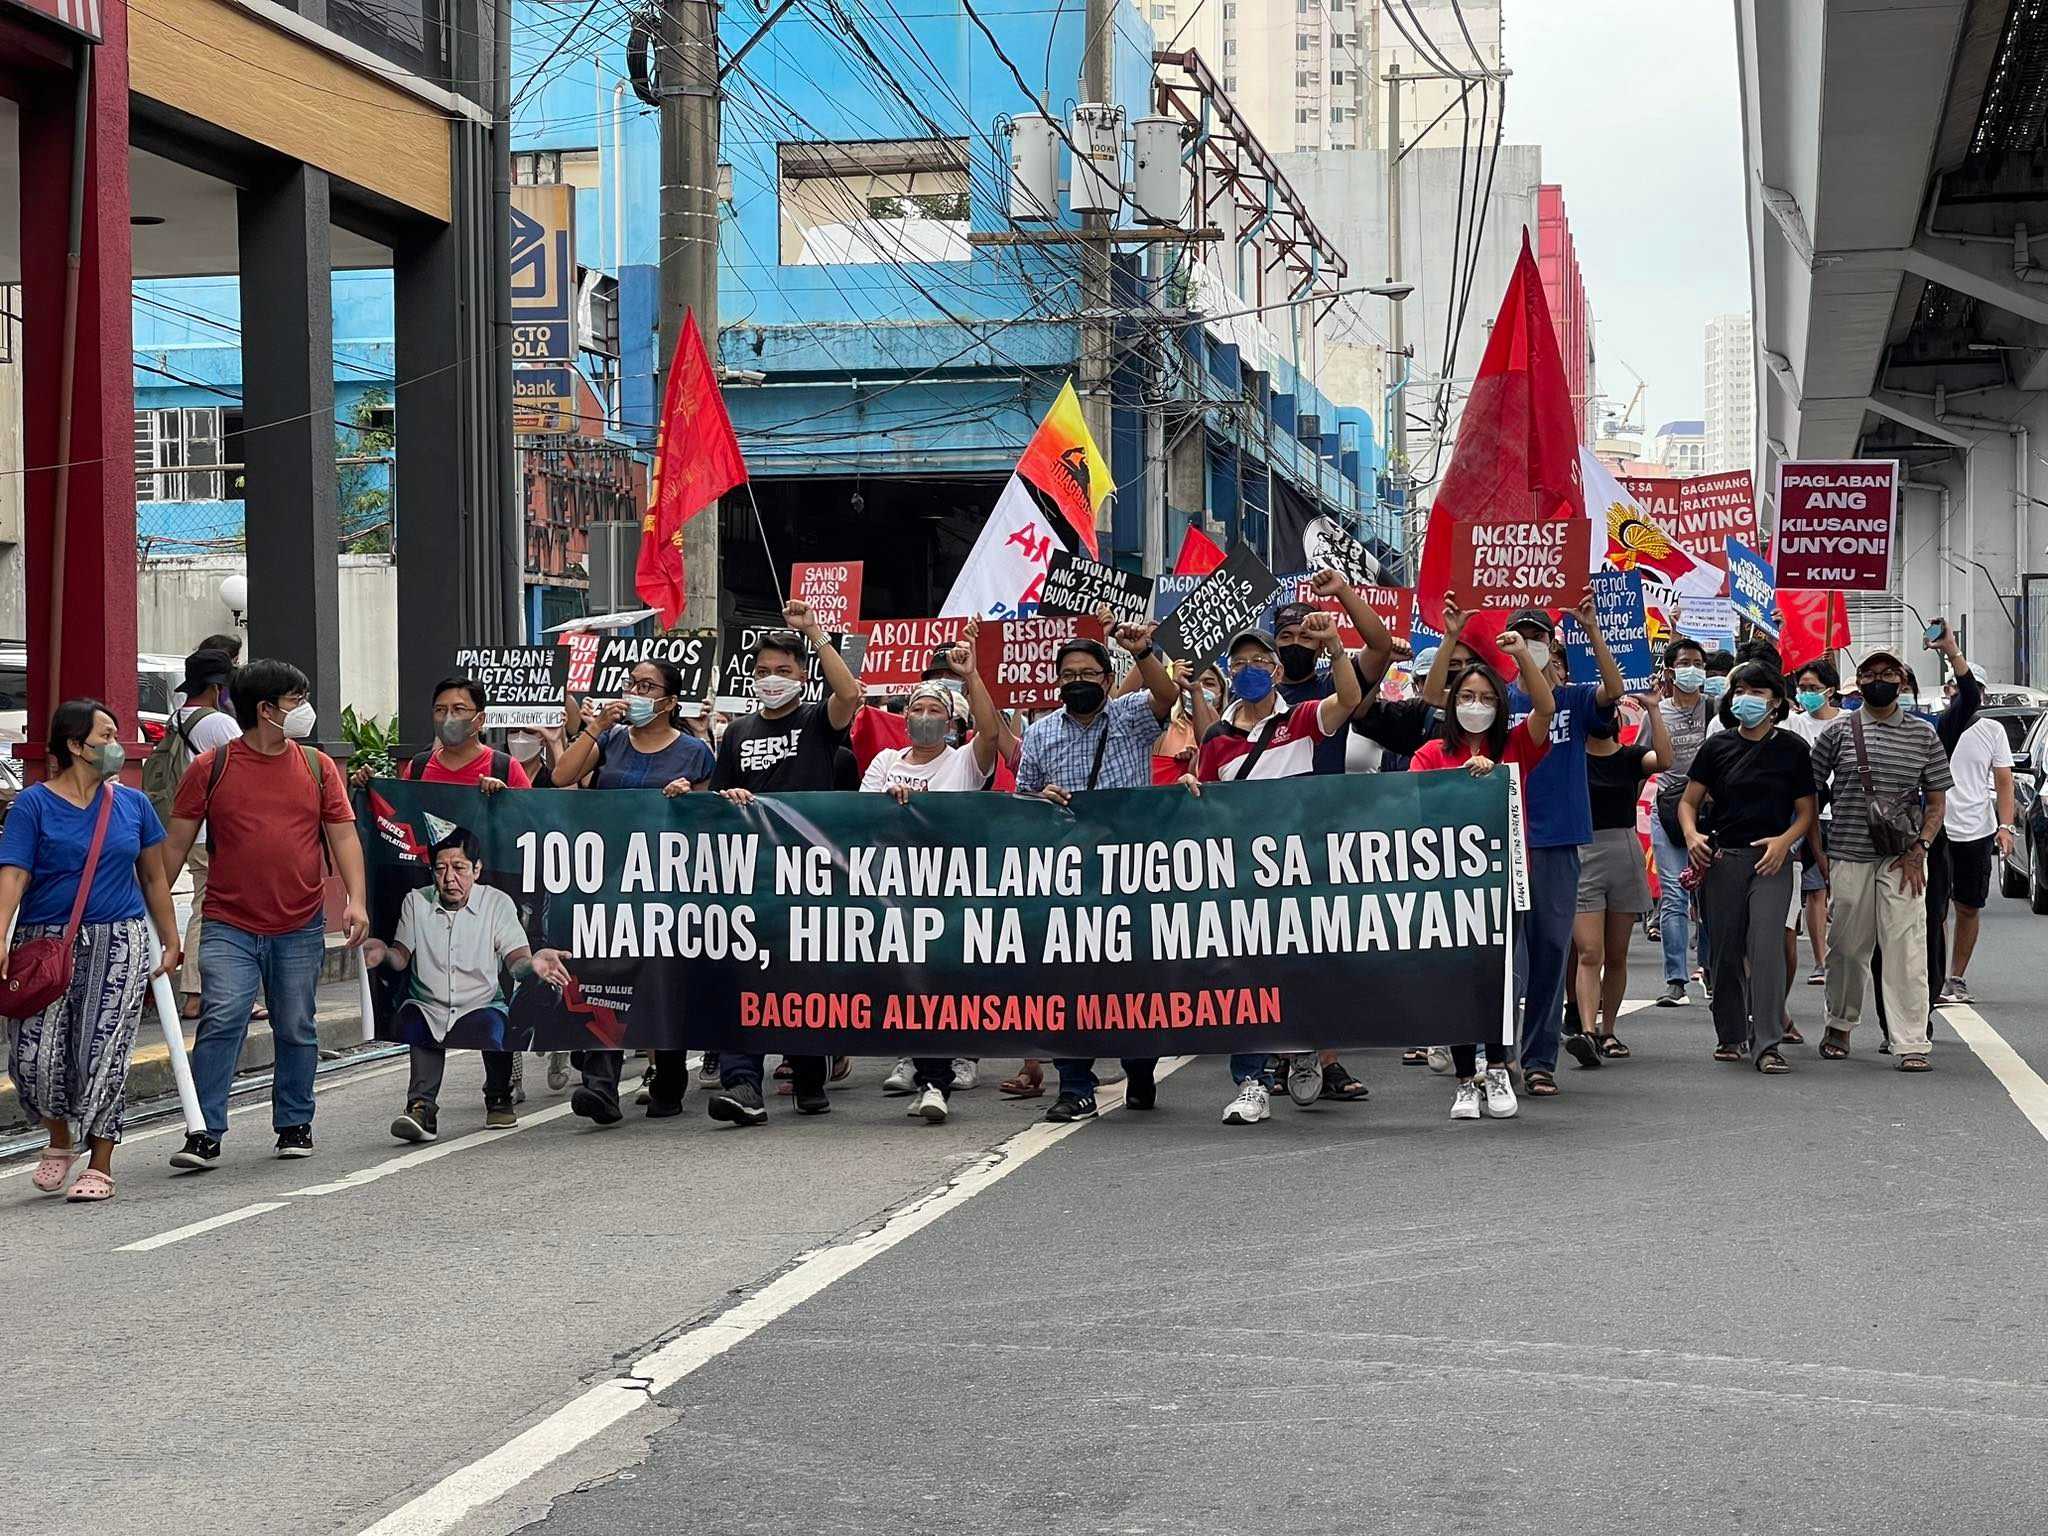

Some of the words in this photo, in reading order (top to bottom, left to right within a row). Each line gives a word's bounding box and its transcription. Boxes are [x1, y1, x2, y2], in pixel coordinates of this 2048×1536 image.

[513, 327, 551, 341] CTO
[512, 342, 549, 356] OLA
[1638, 482, 1653, 492] SA
[1783, 476, 1890, 488] IPAGLABAN
[1805, 492, 1867, 509] ANG
[1472, 523, 1569, 546] INCREASE
[1782, 518, 1888, 532] KILUSANG
[1781, 537, 1886, 555] UNYON!
[1474, 546, 1563, 567] FUNDING
[1071, 556, 1127, 588] TUTULAN
[1472, 568, 1510, 587] FOR
[1513, 566, 1566, 589] SUCs
[1609, 572, 1628, 592] not
[1807, 568, 1856, 580] KMU
[800, 582, 839, 595] ITAAS!
[1050, 568, 1076, 587] ANG
[1078, 576, 1102, 597] 2.5
[1102, 585, 1148, 612] BILLION
[1160, 576, 1201, 593] DAGDA
[1043, 585, 1092, 613] BUDGET
[1113, 605, 1127, 622] SA
[1177, 570, 1227, 622] EXPAND
[1180, 575, 1235, 637] SUPPORT
[1482, 594, 1530, 608] STAND
[1534, 595, 1552, 607] UP
[1183, 580, 1253, 650] SERVICES
[869, 620, 958, 647] ABOLISH
[1002, 618, 1078, 642] RESTORE
[1194, 625, 1224, 659] FOR
[1225, 598, 1255, 632] ALL
[456, 649, 545, 668] IPAGLABAN
[601, 638, 703, 665] MARCOS
[860, 649, 934, 673] NTF-ELC
[528, 669, 551, 686] NA
[997, 663, 1032, 684] FOR
[1035, 662, 1058, 684] SU
[1010, 689, 1037, 704] LFS
[378, 815, 405, 838] PRICES
[380, 831, 411, 851] INFLATION
[399, 852, 417, 861] DEBT
[516, 831, 604, 895] 100
[621, 832, 759, 896] ARAW
[775, 846, 832, 896] NG
[849, 846, 1082, 897] KAWALANG
[1097, 837, 1236, 896] TUGON
[1251, 834, 1312, 888] SA
[1326, 824, 1503, 885] KRISIS:
[572, 902, 770, 971] MARCOS,
[789, 906, 945, 964] HIRAP
[963, 907, 1026, 964] NA
[1042, 904, 1132, 964] ANG
[1151, 887, 1505, 961] MAMAMAYAN!
[578, 984, 602, 993] PESO
[605, 985, 633, 995] VALUE
[586, 996, 631, 1012] ECONOMY
[740, 991, 871, 1029] BAGONG
[883, 994, 1065, 1032] ALYANSANG
[1077, 986, 1281, 1031] MAKABAYAN
